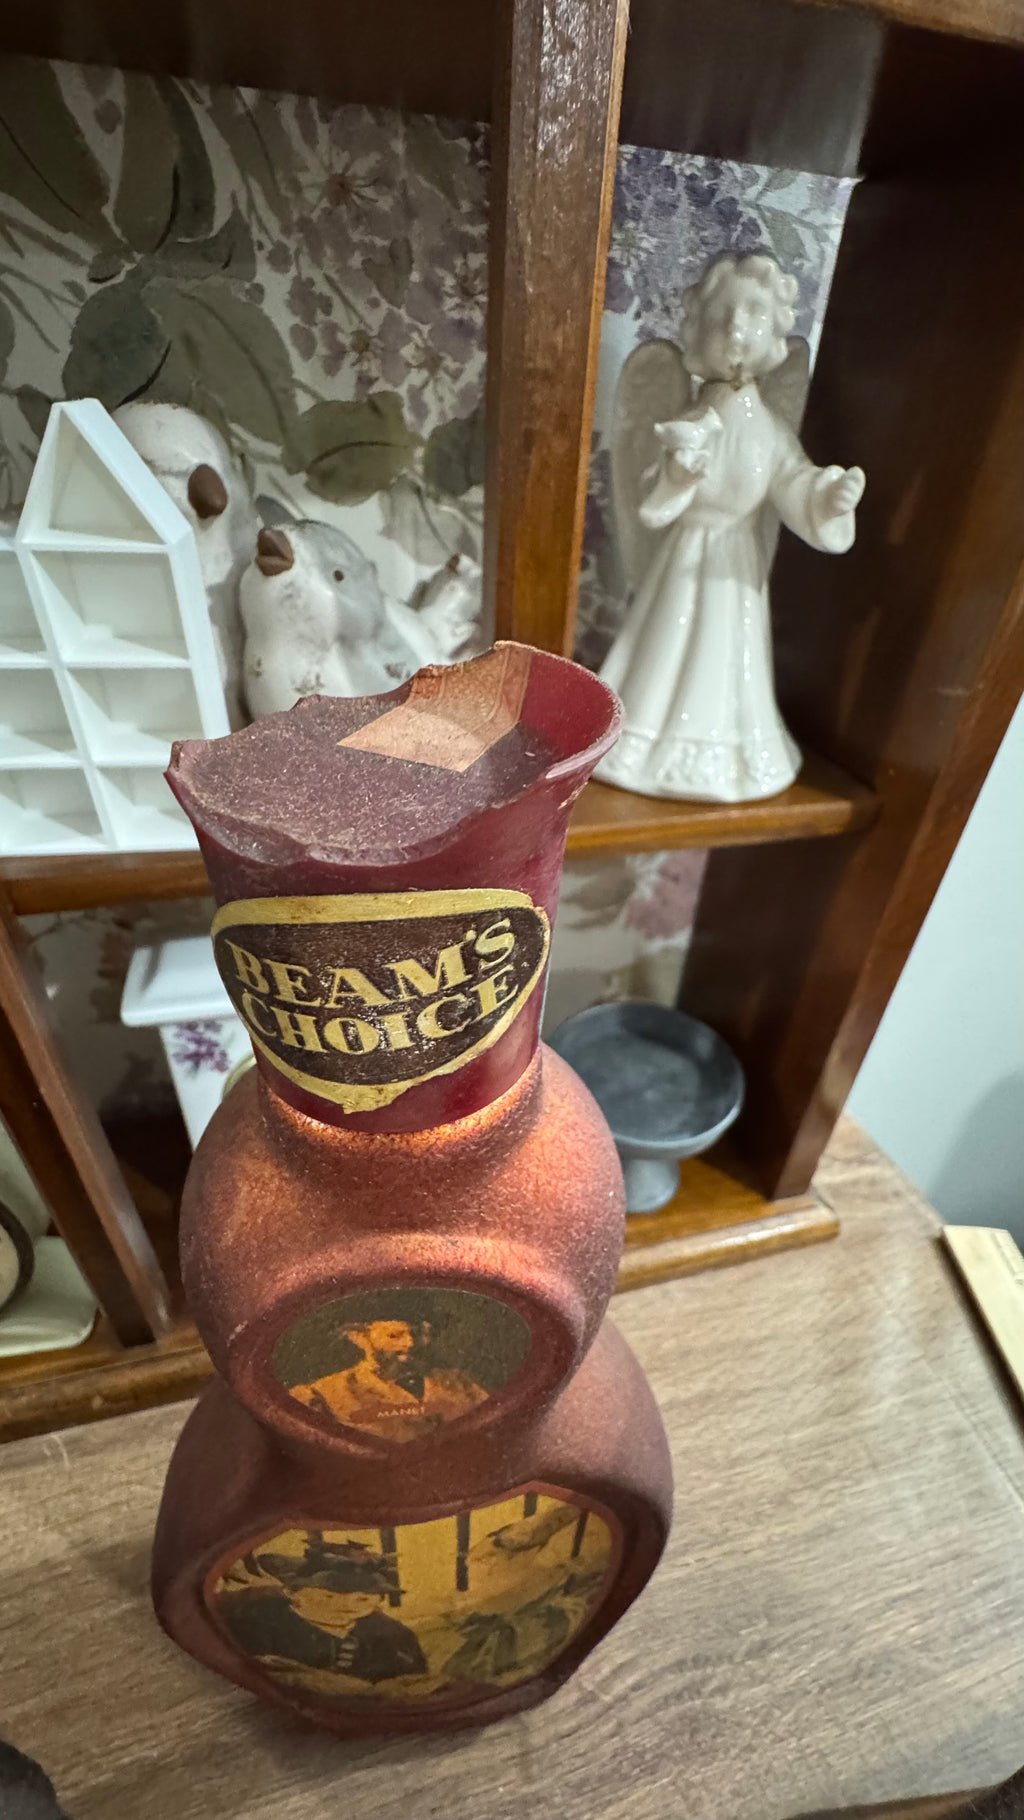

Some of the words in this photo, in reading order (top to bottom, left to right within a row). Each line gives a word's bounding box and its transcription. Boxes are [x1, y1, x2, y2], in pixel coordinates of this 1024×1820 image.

[224, 918, 516, 1009] BEAM'S
[241, 965, 519, 1055] CHOICE
[376, 1405, 426, 1418] MANET
